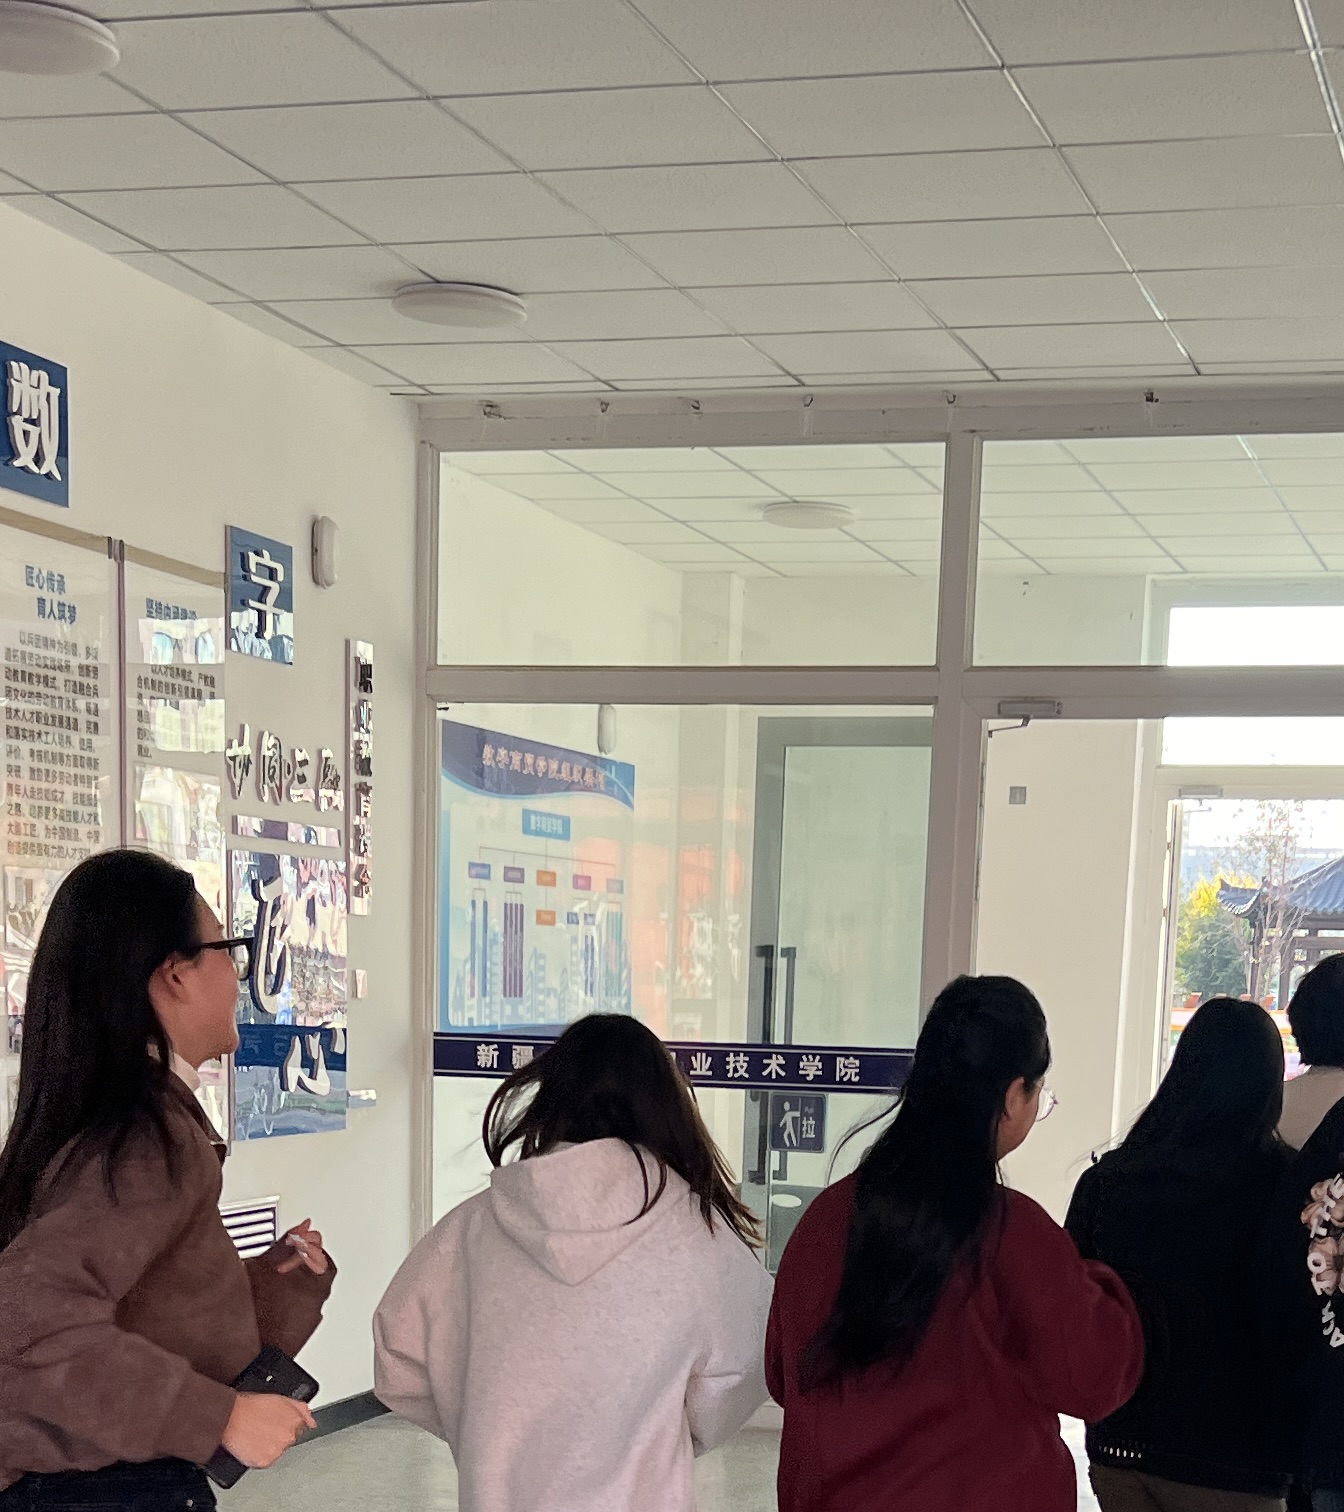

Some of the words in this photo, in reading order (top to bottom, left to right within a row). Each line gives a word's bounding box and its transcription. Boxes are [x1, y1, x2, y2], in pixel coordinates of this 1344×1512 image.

[9, 360, 62, 482] 数
[25, 564, 67, 595] 匠心传承
[247, 548, 285, 641] 字
[36, 596, 77, 625] 育人筑梦
[802, 1116, 816, 1138] 拉
